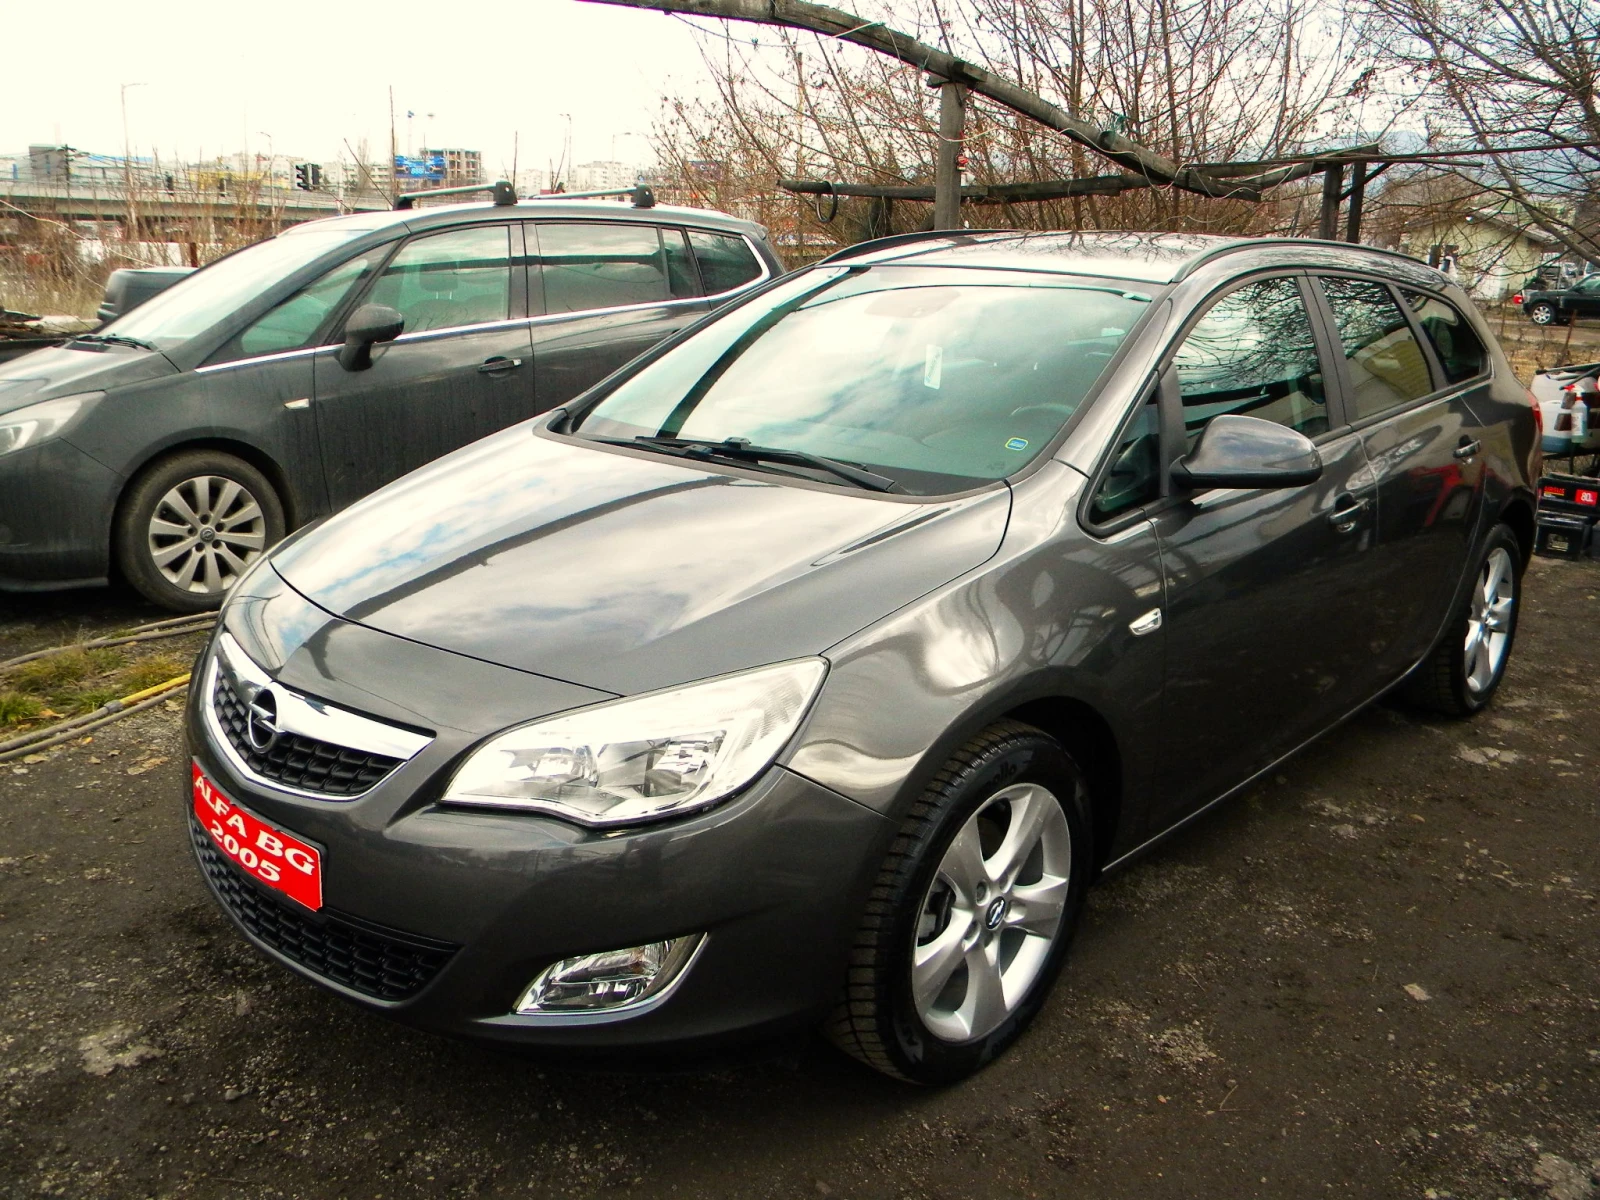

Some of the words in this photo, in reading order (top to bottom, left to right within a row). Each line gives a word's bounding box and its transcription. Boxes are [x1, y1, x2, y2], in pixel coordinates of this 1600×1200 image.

[195, 775, 247, 838] ALFA
[255, 829, 316, 876] BG
[210, 819, 281, 883] 2005
